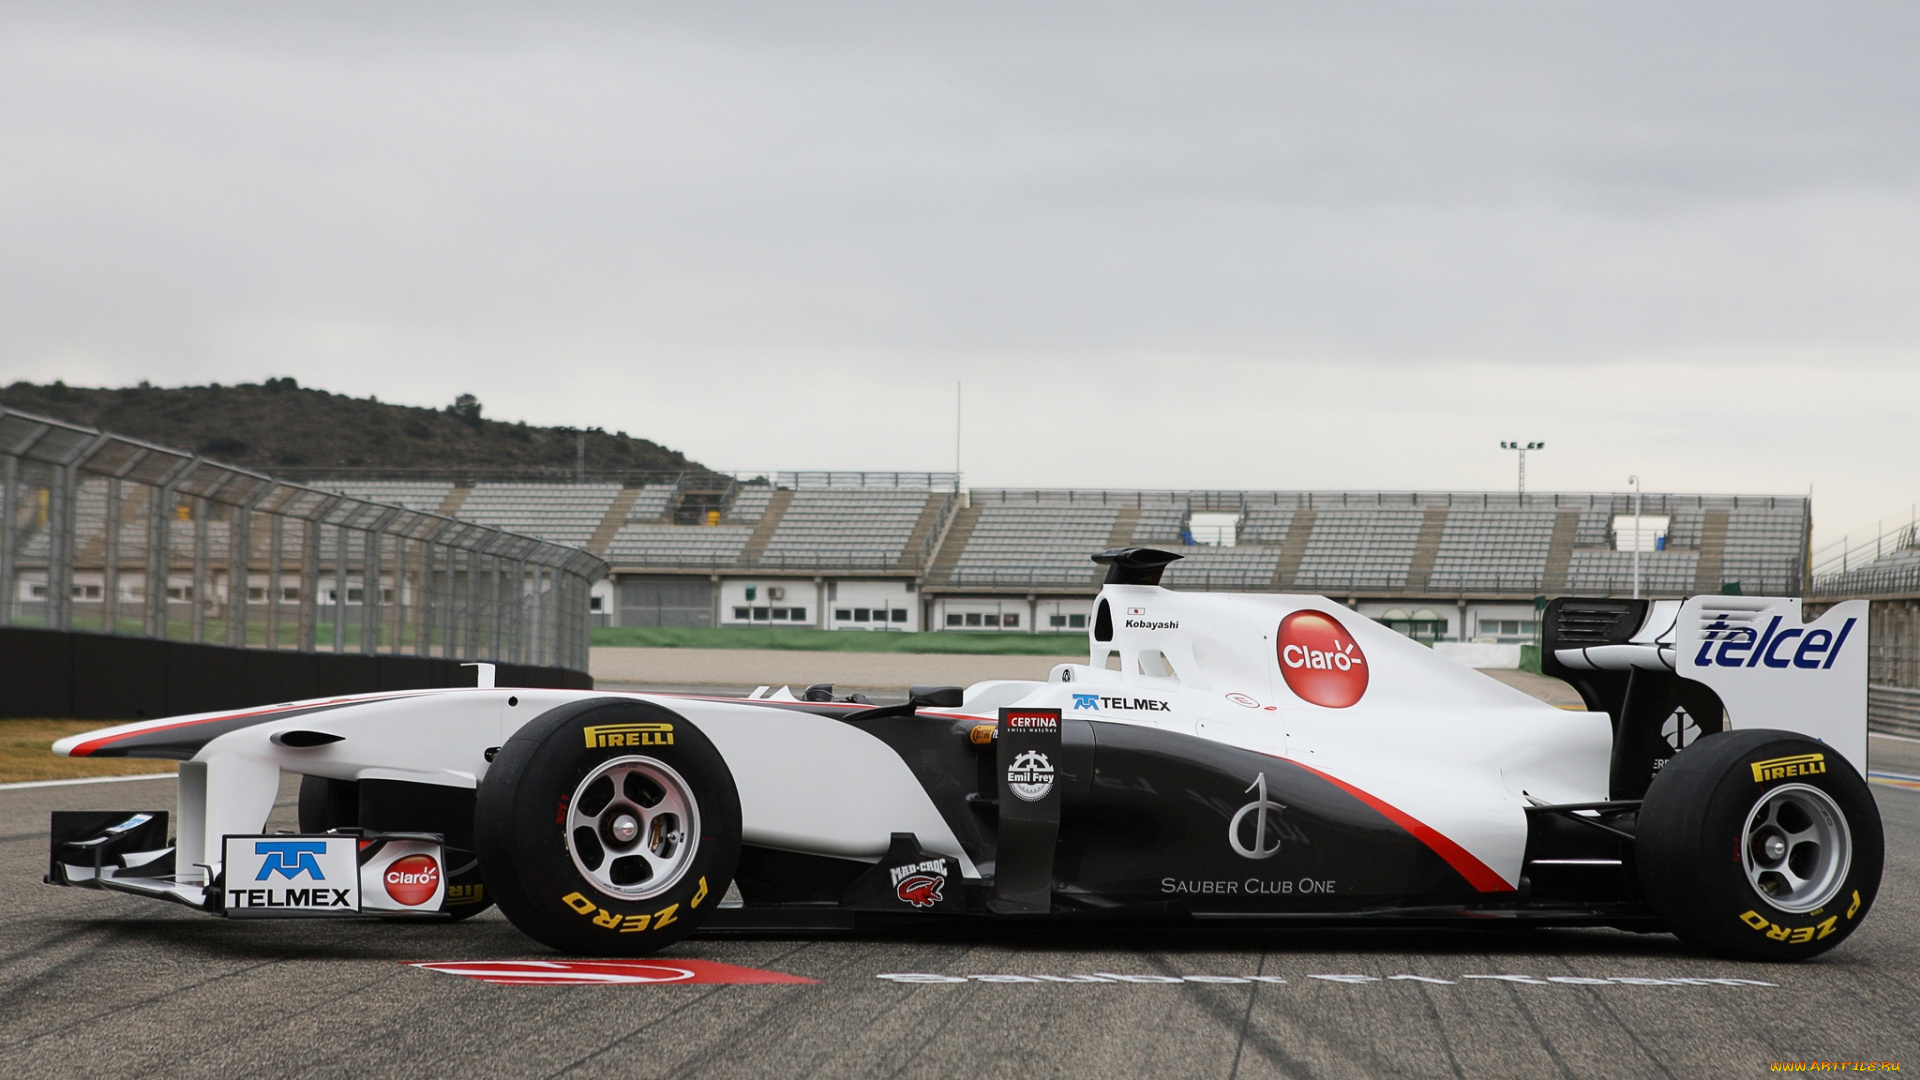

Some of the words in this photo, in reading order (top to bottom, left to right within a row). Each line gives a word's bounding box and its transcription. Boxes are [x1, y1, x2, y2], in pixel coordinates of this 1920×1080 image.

[1125, 619, 1179, 630] Kobayashi
[1694, 614, 1857, 670] telcel
[1283, 642, 1354, 671] Claro
[1100, 697, 1171, 712] TELMEX
[583, 722, 675, 748] PIRELLI
[1011, 717, 1057, 727] CERTINA
[1007, 772, 1031, 782] Emil
[1032, 772, 1054, 784] Frey
[1751, 753, 1827, 783] PIRELLI
[387, 869, 433, 884] Claro
[1161, 877, 1238, 894] SAUBER
[1245, 878, 1293, 894] CLUB
[1299, 878, 1336, 894] ONE
[228, 889, 350, 907] TELMEX
[691, 875, 709, 909] P
[1847, 889, 1861, 920] P
[562, 891, 679, 933] ZERO
[1739, 910, 1838, 944] ZERO
